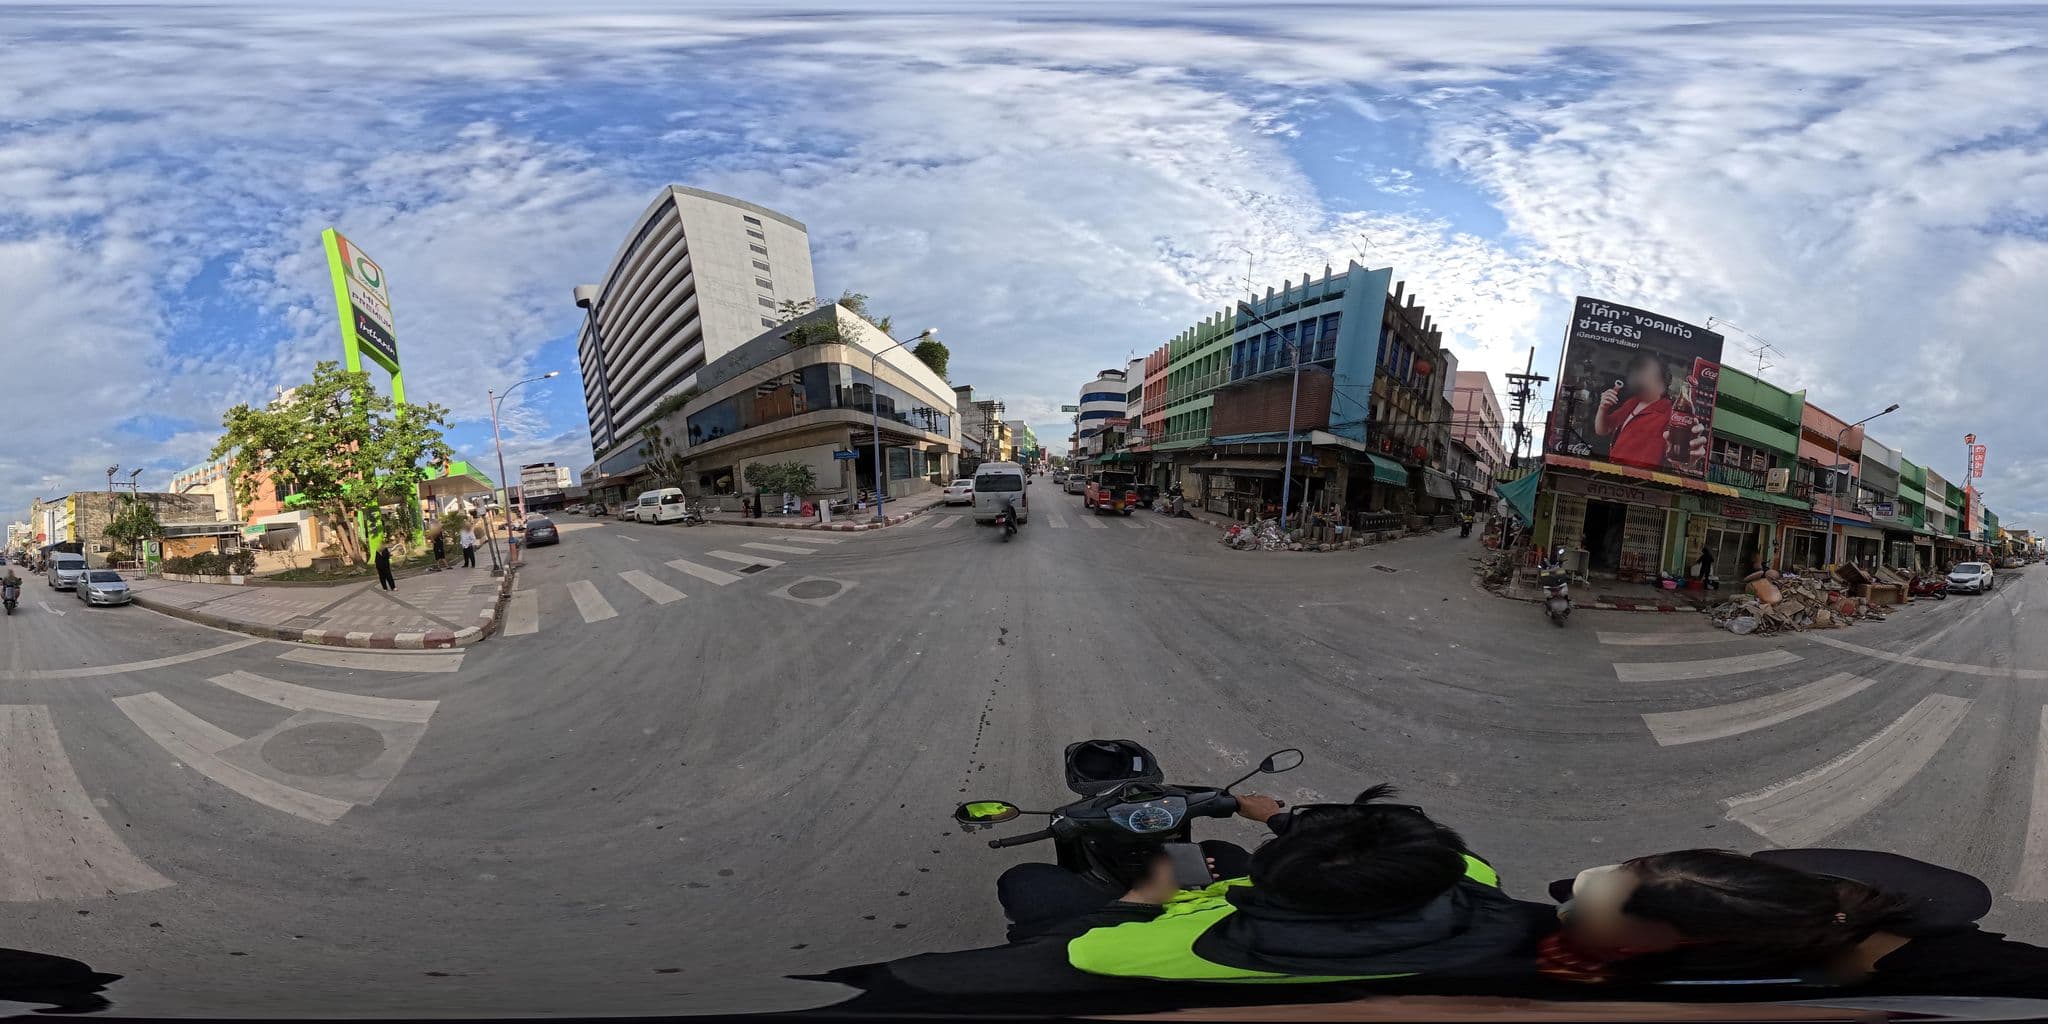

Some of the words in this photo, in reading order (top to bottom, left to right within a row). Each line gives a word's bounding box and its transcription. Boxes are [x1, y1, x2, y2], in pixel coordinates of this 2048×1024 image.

[352, 292, 392, 330] PREMIUM
[1579, 316, 1642, 340] ซ่าส์จริง
[1634, 314, 1693, 339] ขวดแก้ว
